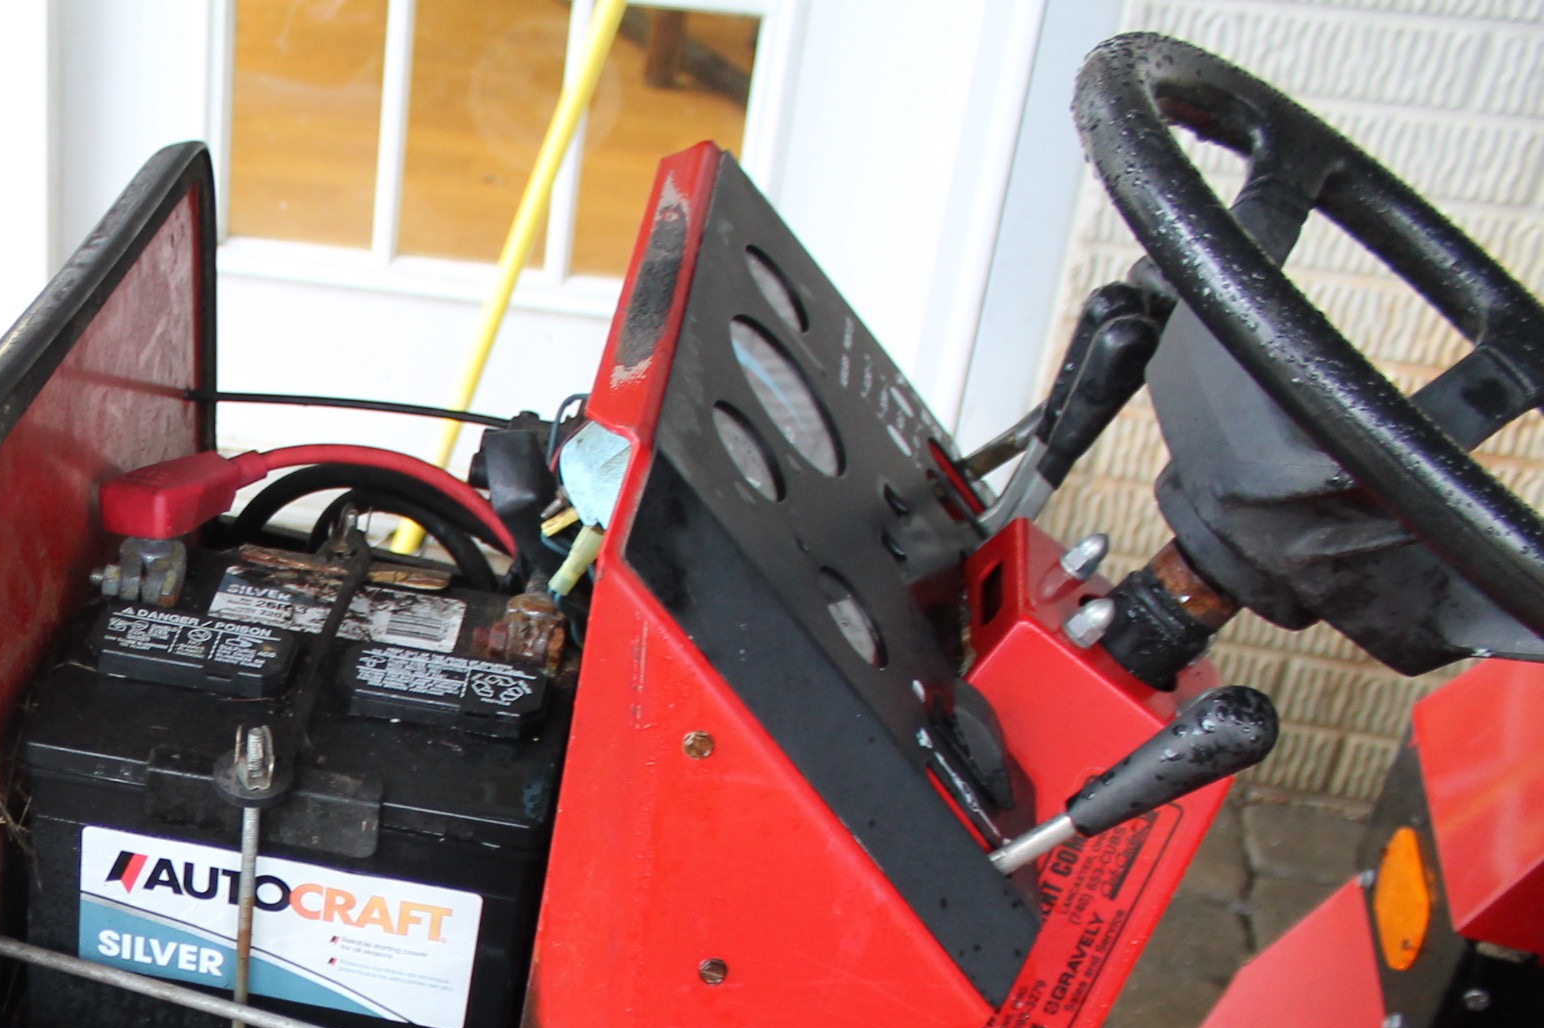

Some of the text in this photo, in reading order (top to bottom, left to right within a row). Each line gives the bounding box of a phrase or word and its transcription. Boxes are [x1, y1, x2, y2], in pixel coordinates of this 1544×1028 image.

[225, 583, 292, 601] SILVER
[135, 608, 200, 626] DANGER
[214, 622, 272, 637] POISON
[143, 857, 453, 943] AUTOCRAFT
[1069, 893, 1092, 925] (740)
[97, 929, 225, 978] SILVER
[1052, 912, 1105, 1002] GRAVELY
[1063, 906, 1126, 1013] Sales and Service
